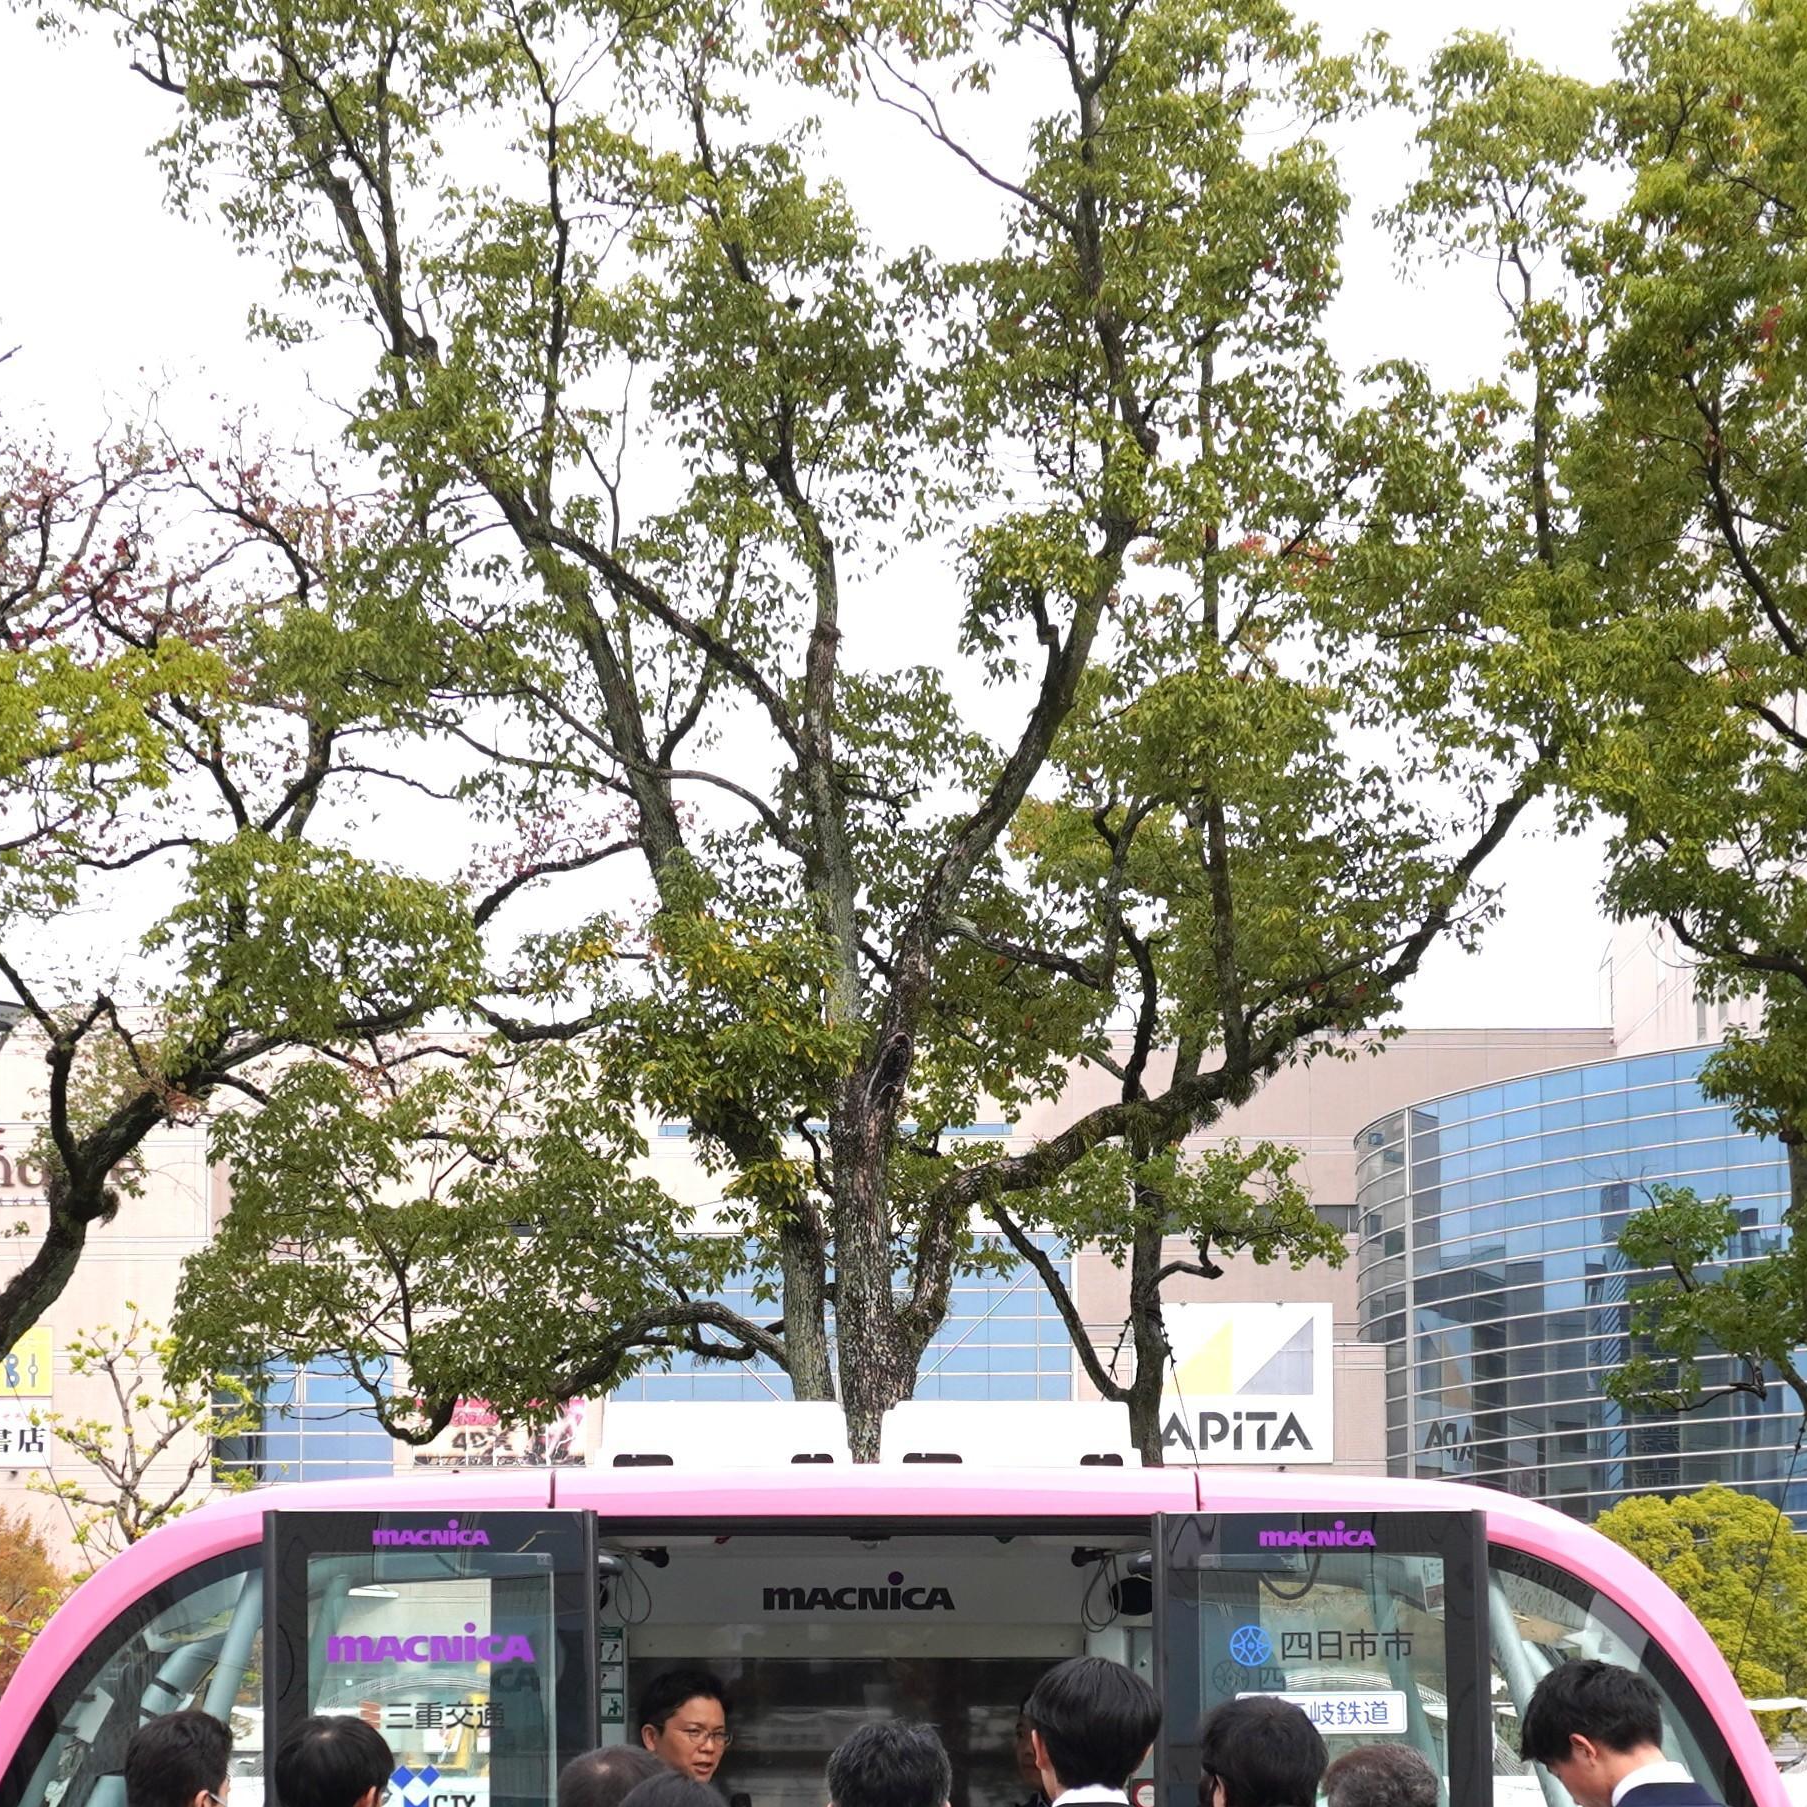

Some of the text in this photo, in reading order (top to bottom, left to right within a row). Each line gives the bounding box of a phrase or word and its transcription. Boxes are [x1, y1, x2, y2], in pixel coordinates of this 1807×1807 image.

[1281, 1628, 1414, 1661] 四日市市
[386, 1702, 505, 1729] 三重交通
